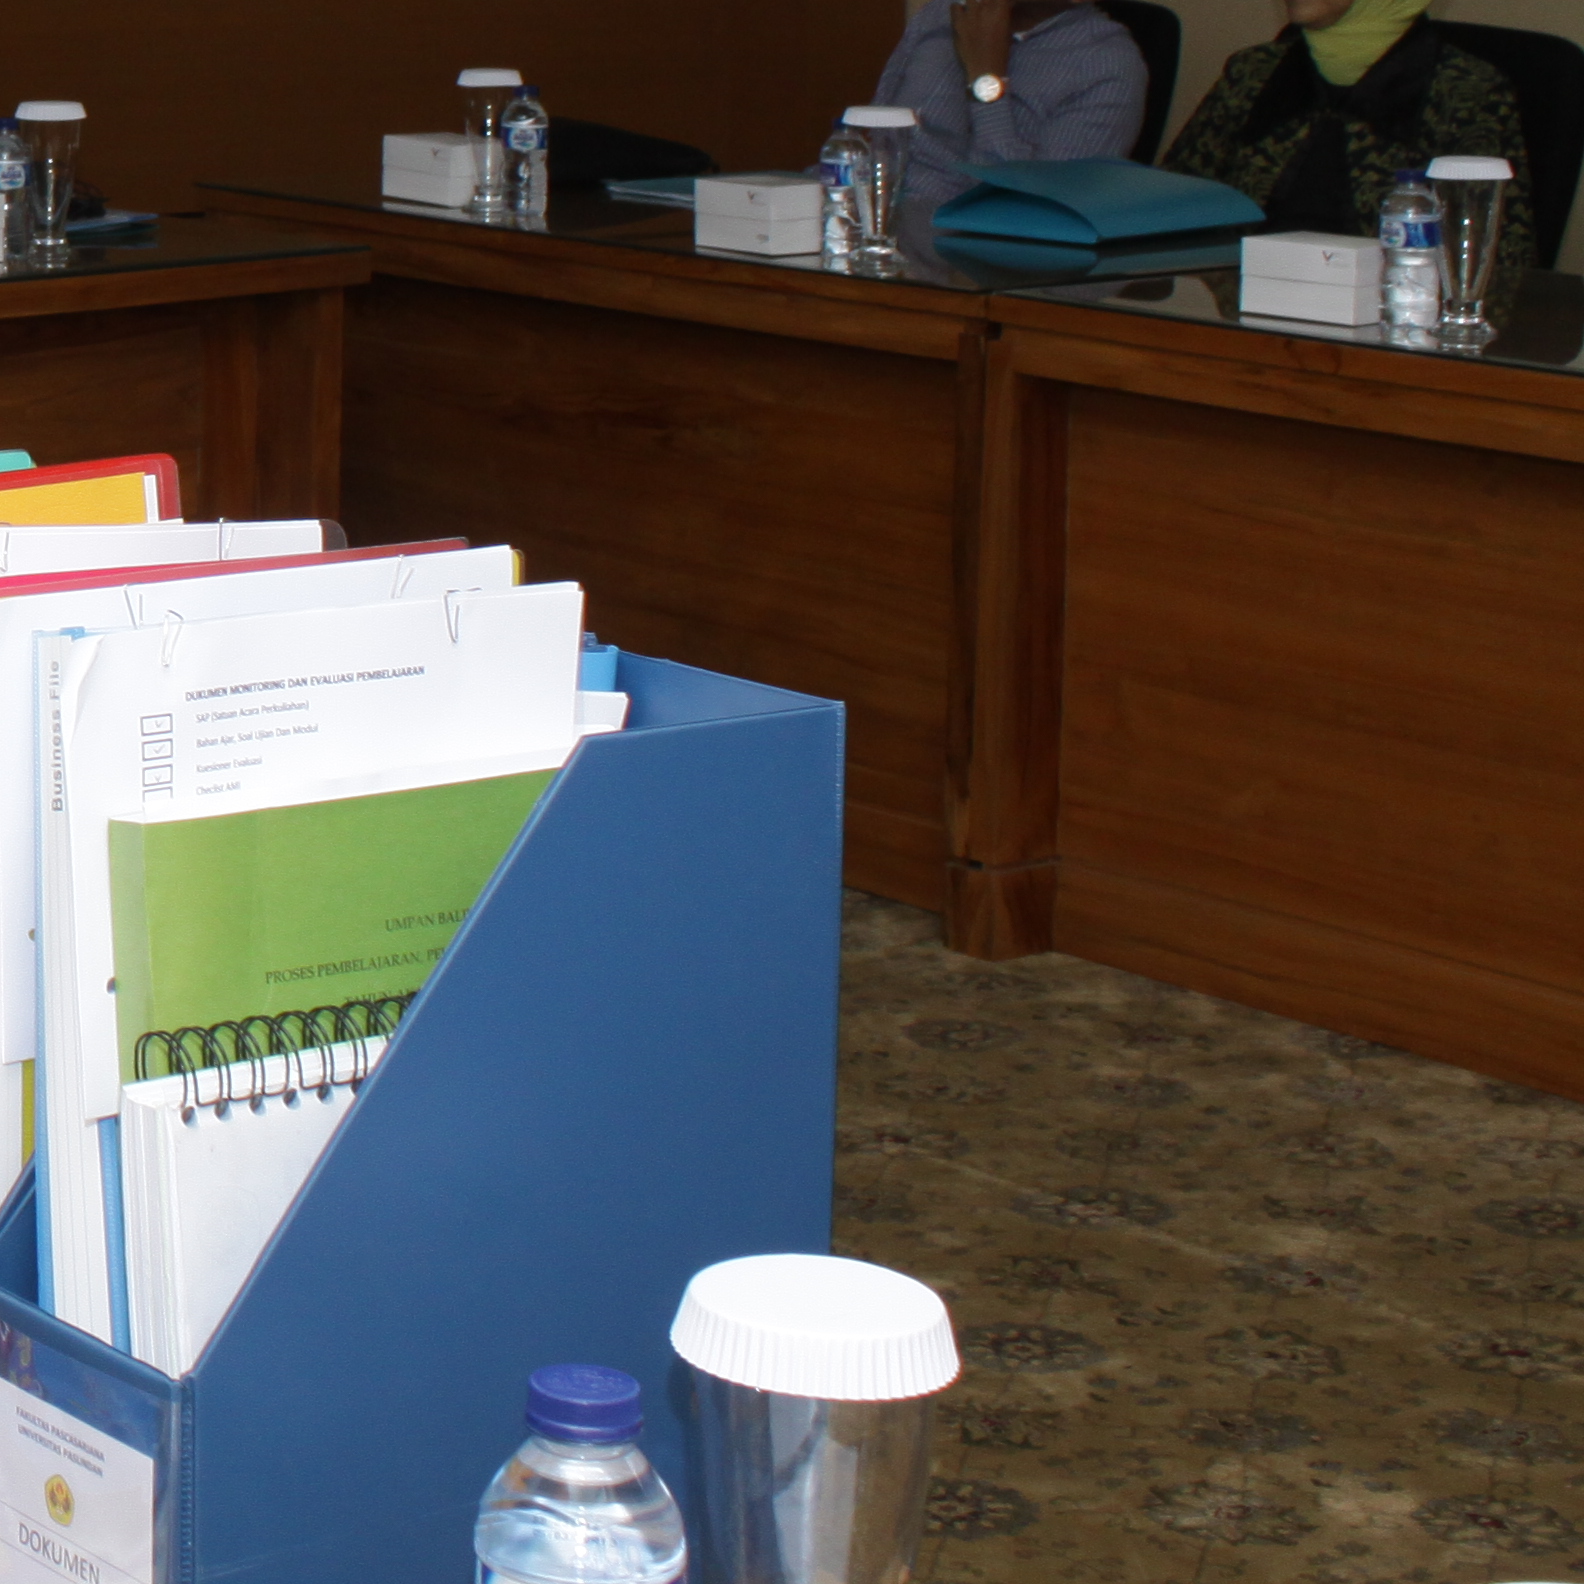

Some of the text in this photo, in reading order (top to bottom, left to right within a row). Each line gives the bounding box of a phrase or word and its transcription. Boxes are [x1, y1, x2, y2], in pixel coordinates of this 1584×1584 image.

[287, 676, 308, 688] DAN
[310, 672, 354, 686] EVALUASI
[49, 661, 64, 811] Business File
[385, 913, 435, 932] UMPAN
[265, 965, 315, 984] PROSES
[19, 1522, 100, 1584] DOKUMEN
